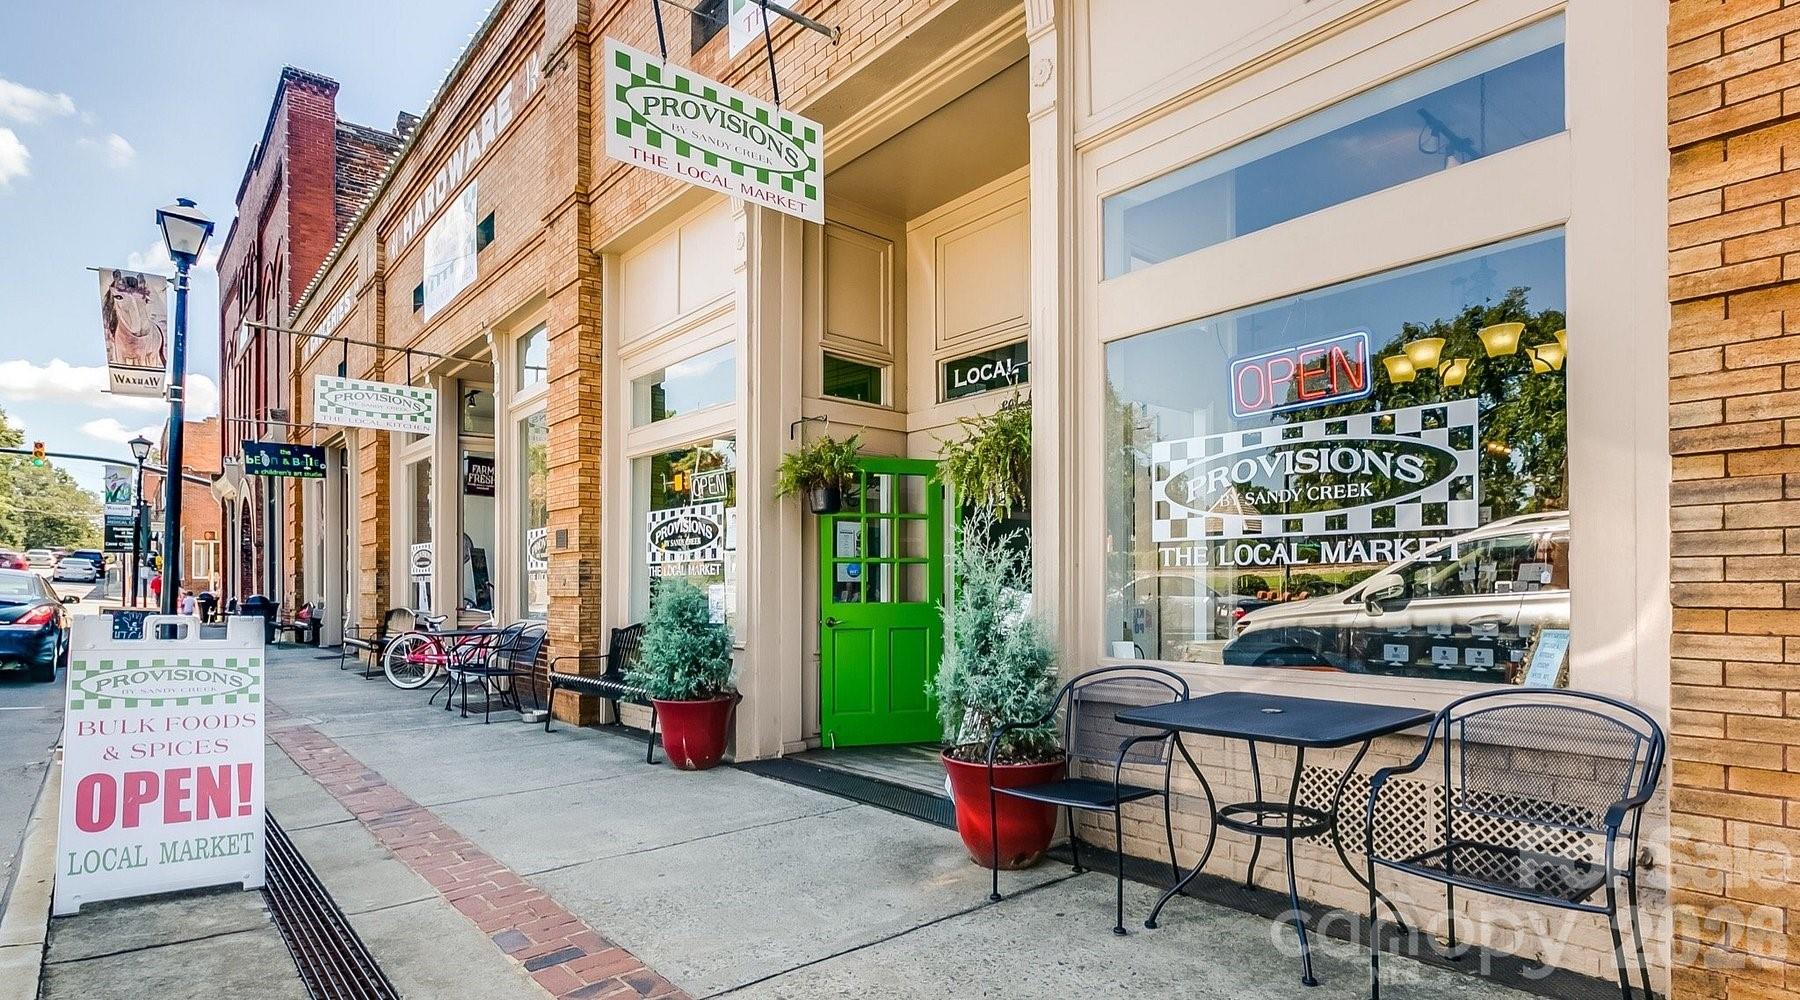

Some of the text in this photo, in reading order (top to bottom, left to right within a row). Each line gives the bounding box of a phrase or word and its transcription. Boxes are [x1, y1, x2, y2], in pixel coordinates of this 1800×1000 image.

[642, 96, 799, 168] PROVISIONS
[670, 123, 773, 165] BY SANDY CREEK
[403, 80, 513, 247] HARDWARE
[629, 146, 809, 213] THE LOCAL MARKET
[954, 358, 1019, 388] LOCAL
[1237, 341, 1365, 409] OPEN
[334, 392, 421, 412] PROVISIONS
[348, 417, 382, 426] LOCAL
[386, 421, 430, 431] KITCHEN
[472, 464, 495, 476] FARM
[1184, 448, 1426, 503] PROVISIONS
[692, 474, 725, 497] OPEN
[1220, 481, 1373, 508] BY SANDY CREEK
[655, 518, 713, 544] PROVISIONS
[1158, 536, 1461, 567] THE LOCAL MARKET
[649, 563, 722, 577] THE LOCAL MARKET
[96, 669, 243, 692] PROVISIONS
[78, 713, 256, 737] BULK FOODS
[103, 737, 229, 761] & SPICES
[75, 763, 253, 833] OPEN!
[67, 832, 255, 877] LOCAL MARKET
